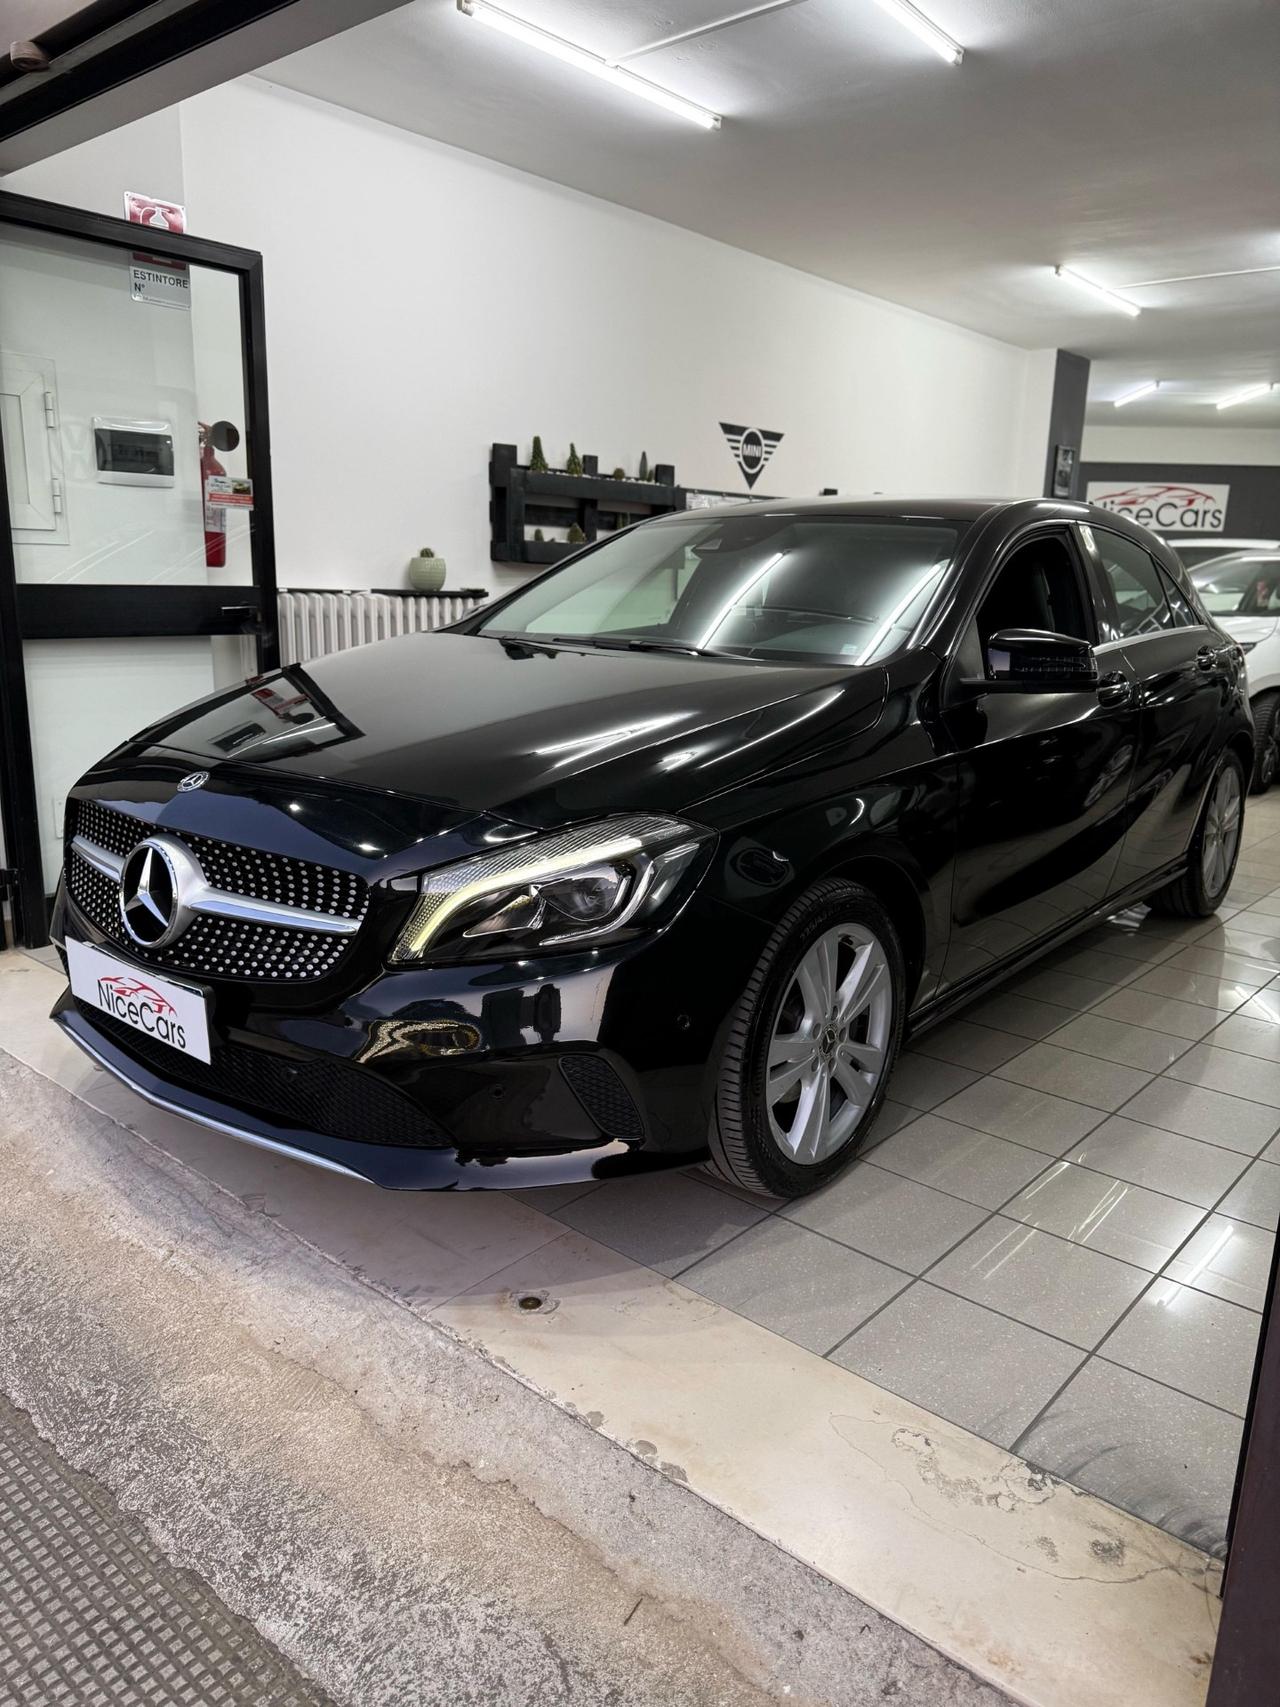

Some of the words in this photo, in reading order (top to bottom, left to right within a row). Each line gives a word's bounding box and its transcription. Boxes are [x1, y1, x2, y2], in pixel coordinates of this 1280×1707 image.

[133, 269, 189, 289] ESTINTORE
[742, 443, 762, 458] MINI
[1088, 499, 1223, 528] eCars
[97, 979, 186, 1049] NiceCars
